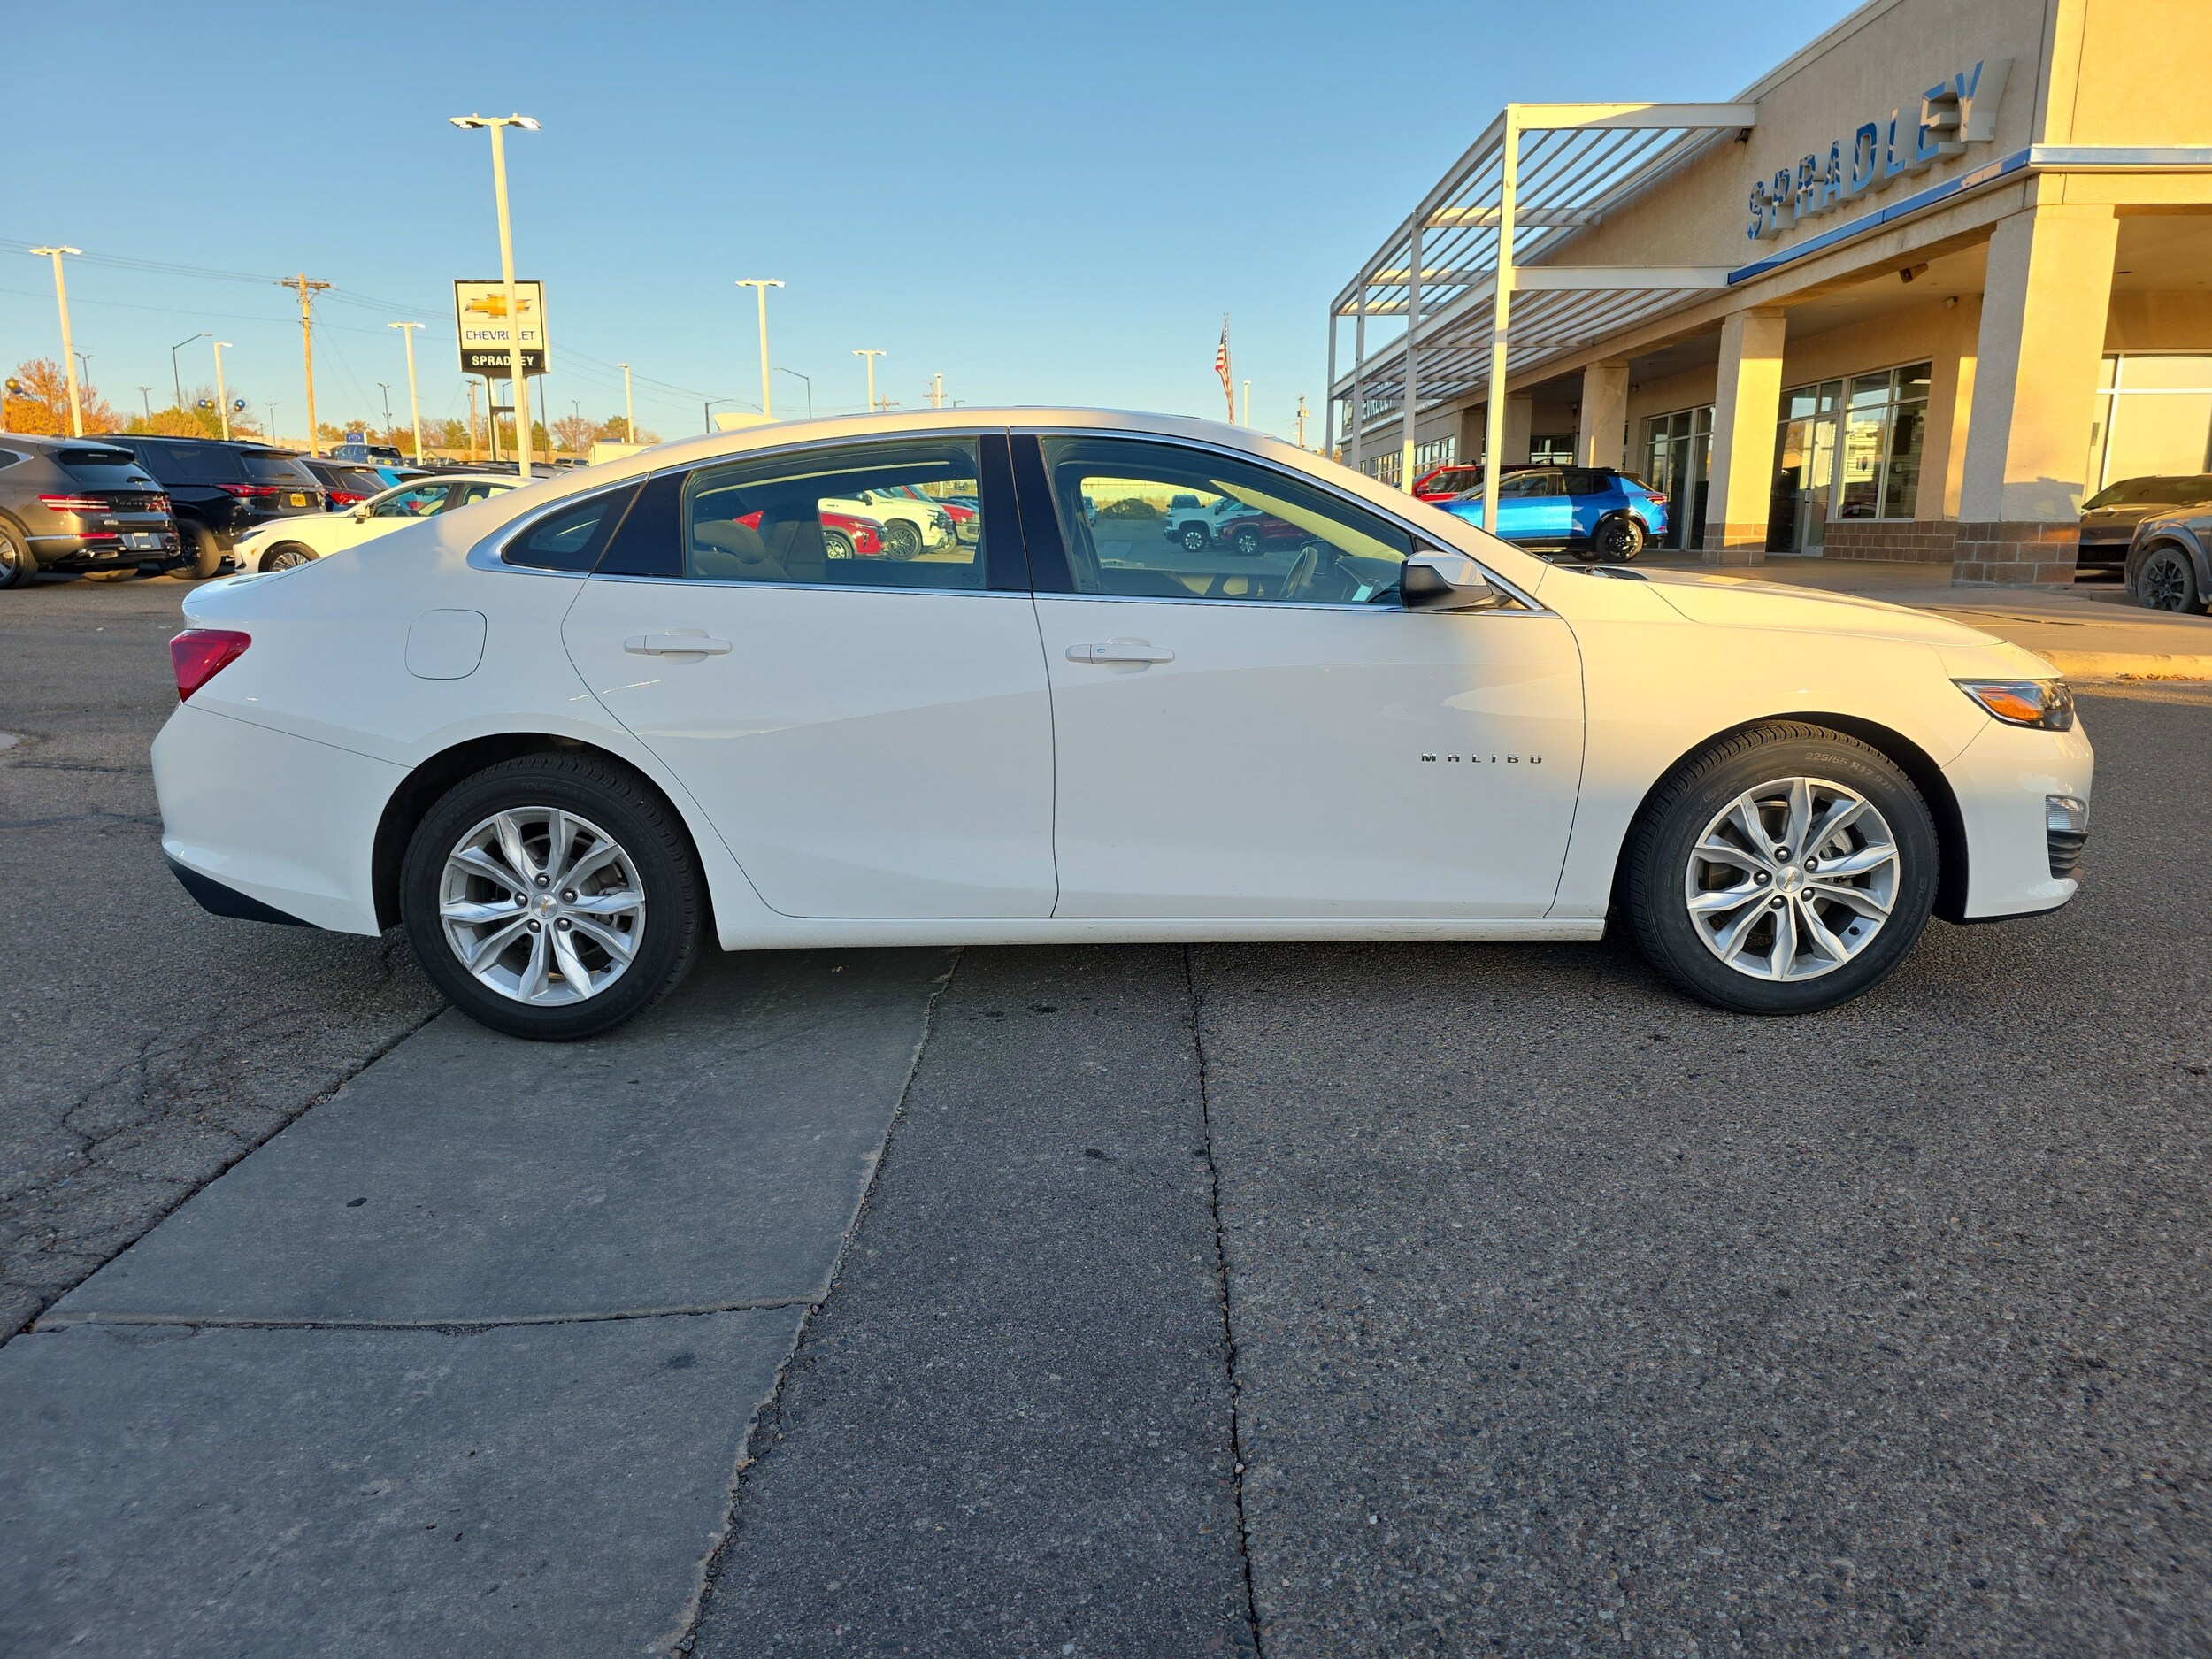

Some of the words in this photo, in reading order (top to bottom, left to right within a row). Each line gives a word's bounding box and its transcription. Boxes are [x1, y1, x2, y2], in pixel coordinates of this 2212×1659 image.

[1747, 58, 1985, 241] SPRADLEY
[465, 330, 535, 341] CHEVRET
[472, 355, 534, 366] SPRADEY
[1421, 752, 1542, 764] MALIBU
[1805, 752, 1848, 765] 225/55
[1849, 761, 1875, 776] R17
[520, 782, 568, 795] TOURING
